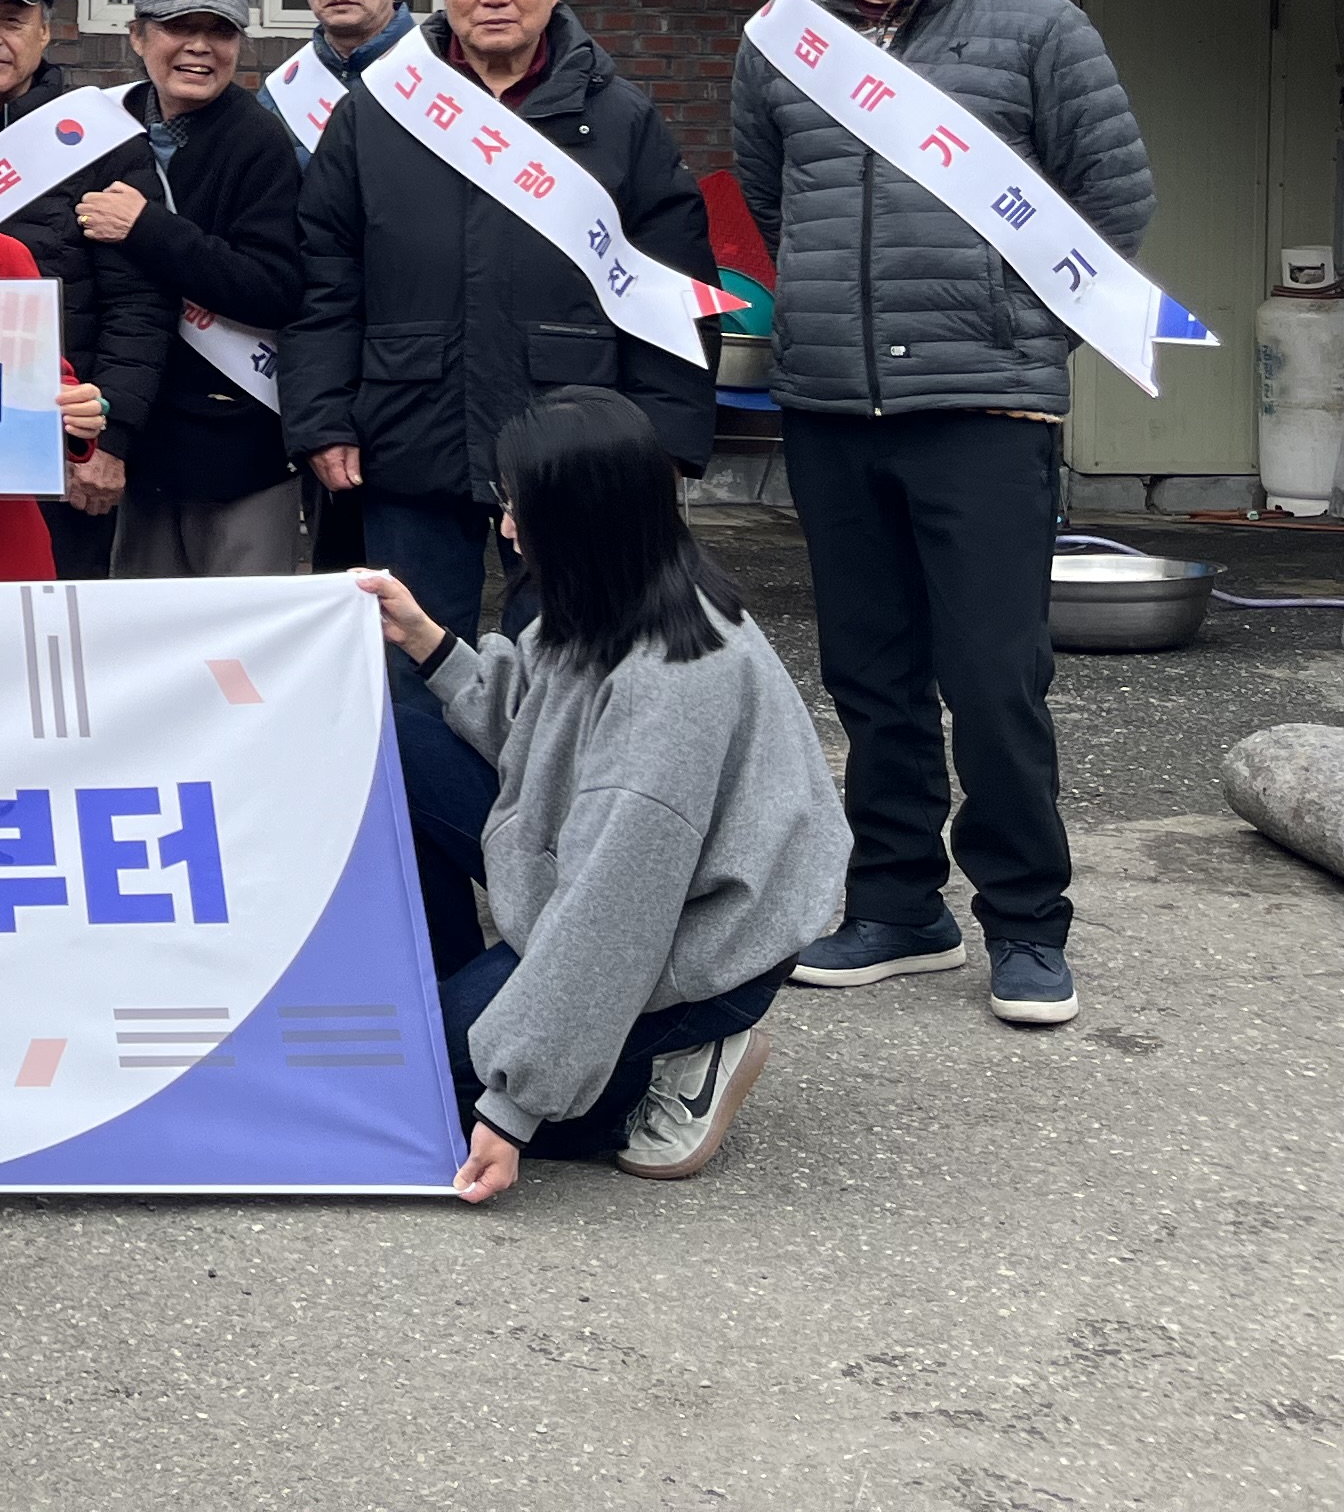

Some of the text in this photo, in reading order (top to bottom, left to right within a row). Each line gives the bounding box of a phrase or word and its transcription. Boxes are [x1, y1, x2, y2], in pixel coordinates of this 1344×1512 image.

[394, 64, 556, 199] 나라사랑
[794, 27, 1098, 293] 태극기 달기
